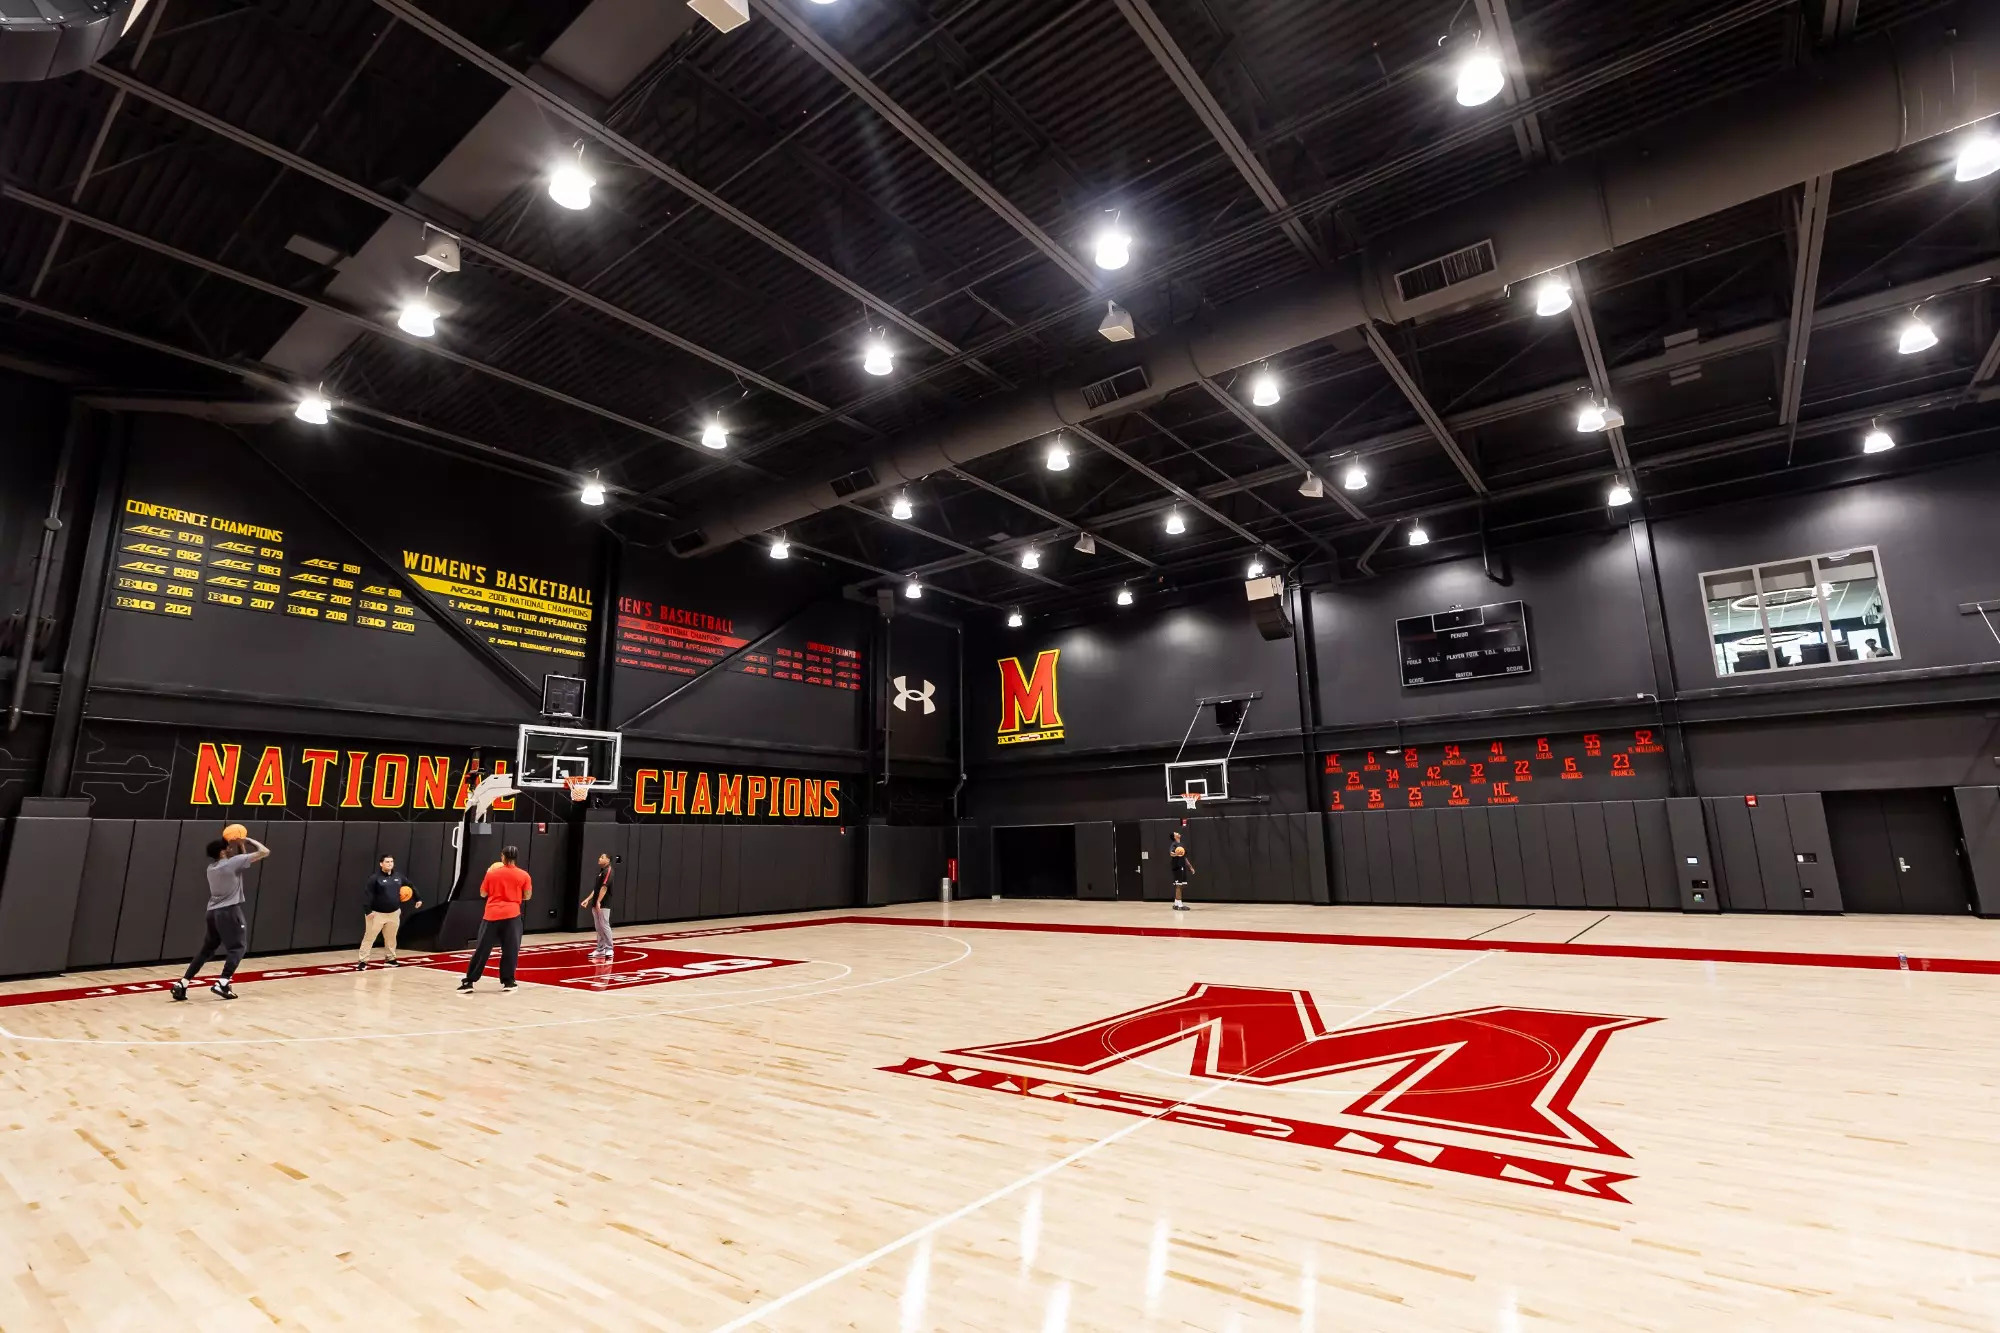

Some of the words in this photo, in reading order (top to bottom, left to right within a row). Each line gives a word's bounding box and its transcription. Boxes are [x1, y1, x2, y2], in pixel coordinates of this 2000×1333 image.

[126, 500, 208, 527] CONFERENCE
[211, 518, 283, 542] CHAMPIONS
[178, 531, 204, 545] 1978
[176, 550, 202, 562] 1982
[261, 547, 283, 560] 1979
[258, 564, 281, 577] 1983
[403, 550, 487, 584] WOMEN'S
[496, 570, 593, 606] BASKETBALL
[253, 581, 280, 594] 2009
[250, 598, 275, 610] 2017
[510, 596, 545, 610] NATIONAL
[547, 604, 589, 618] CHAMPIONS
[494, 607, 516, 619] FINAL
[517, 612, 537, 623] FOUR
[539, 616, 588, 632] APPEARANCES
[660, 605, 734, 634] BASKETBALL
[998, 649, 1064, 733] M
[1584, 734, 1600, 749] 55
[1635, 730, 1653, 745] 52
[1444, 745, 1460, 758] 54
[1491, 742, 1503, 755] 41
[1537, 738, 1549, 752] 15
[1326, 754, 1340, 767] HC
[1367, 752, 1375, 764] 6
[1564, 757, 1576, 771] 15
[1612, 754, 1630, 769] 23
[1427, 766, 1441, 779] 42
[1470, 764, 1485, 777] 32
[1514, 760, 1530, 774] 22
[190, 742, 514, 810] NATIONAL
[1348, 771, 1360, 784] 25
[1386, 769, 1399, 782] 34
[634, 769, 840, 818] CHAMPIONS
[1368, 789, 1381, 802] 35
[1408, 787, 1422, 800] 25
[1452, 785, 1463, 798] 21
[1493, 782, 1511, 796] HC
[1333, 791, 1340, 803] 3
[940, 982, 1667, 1159] M
